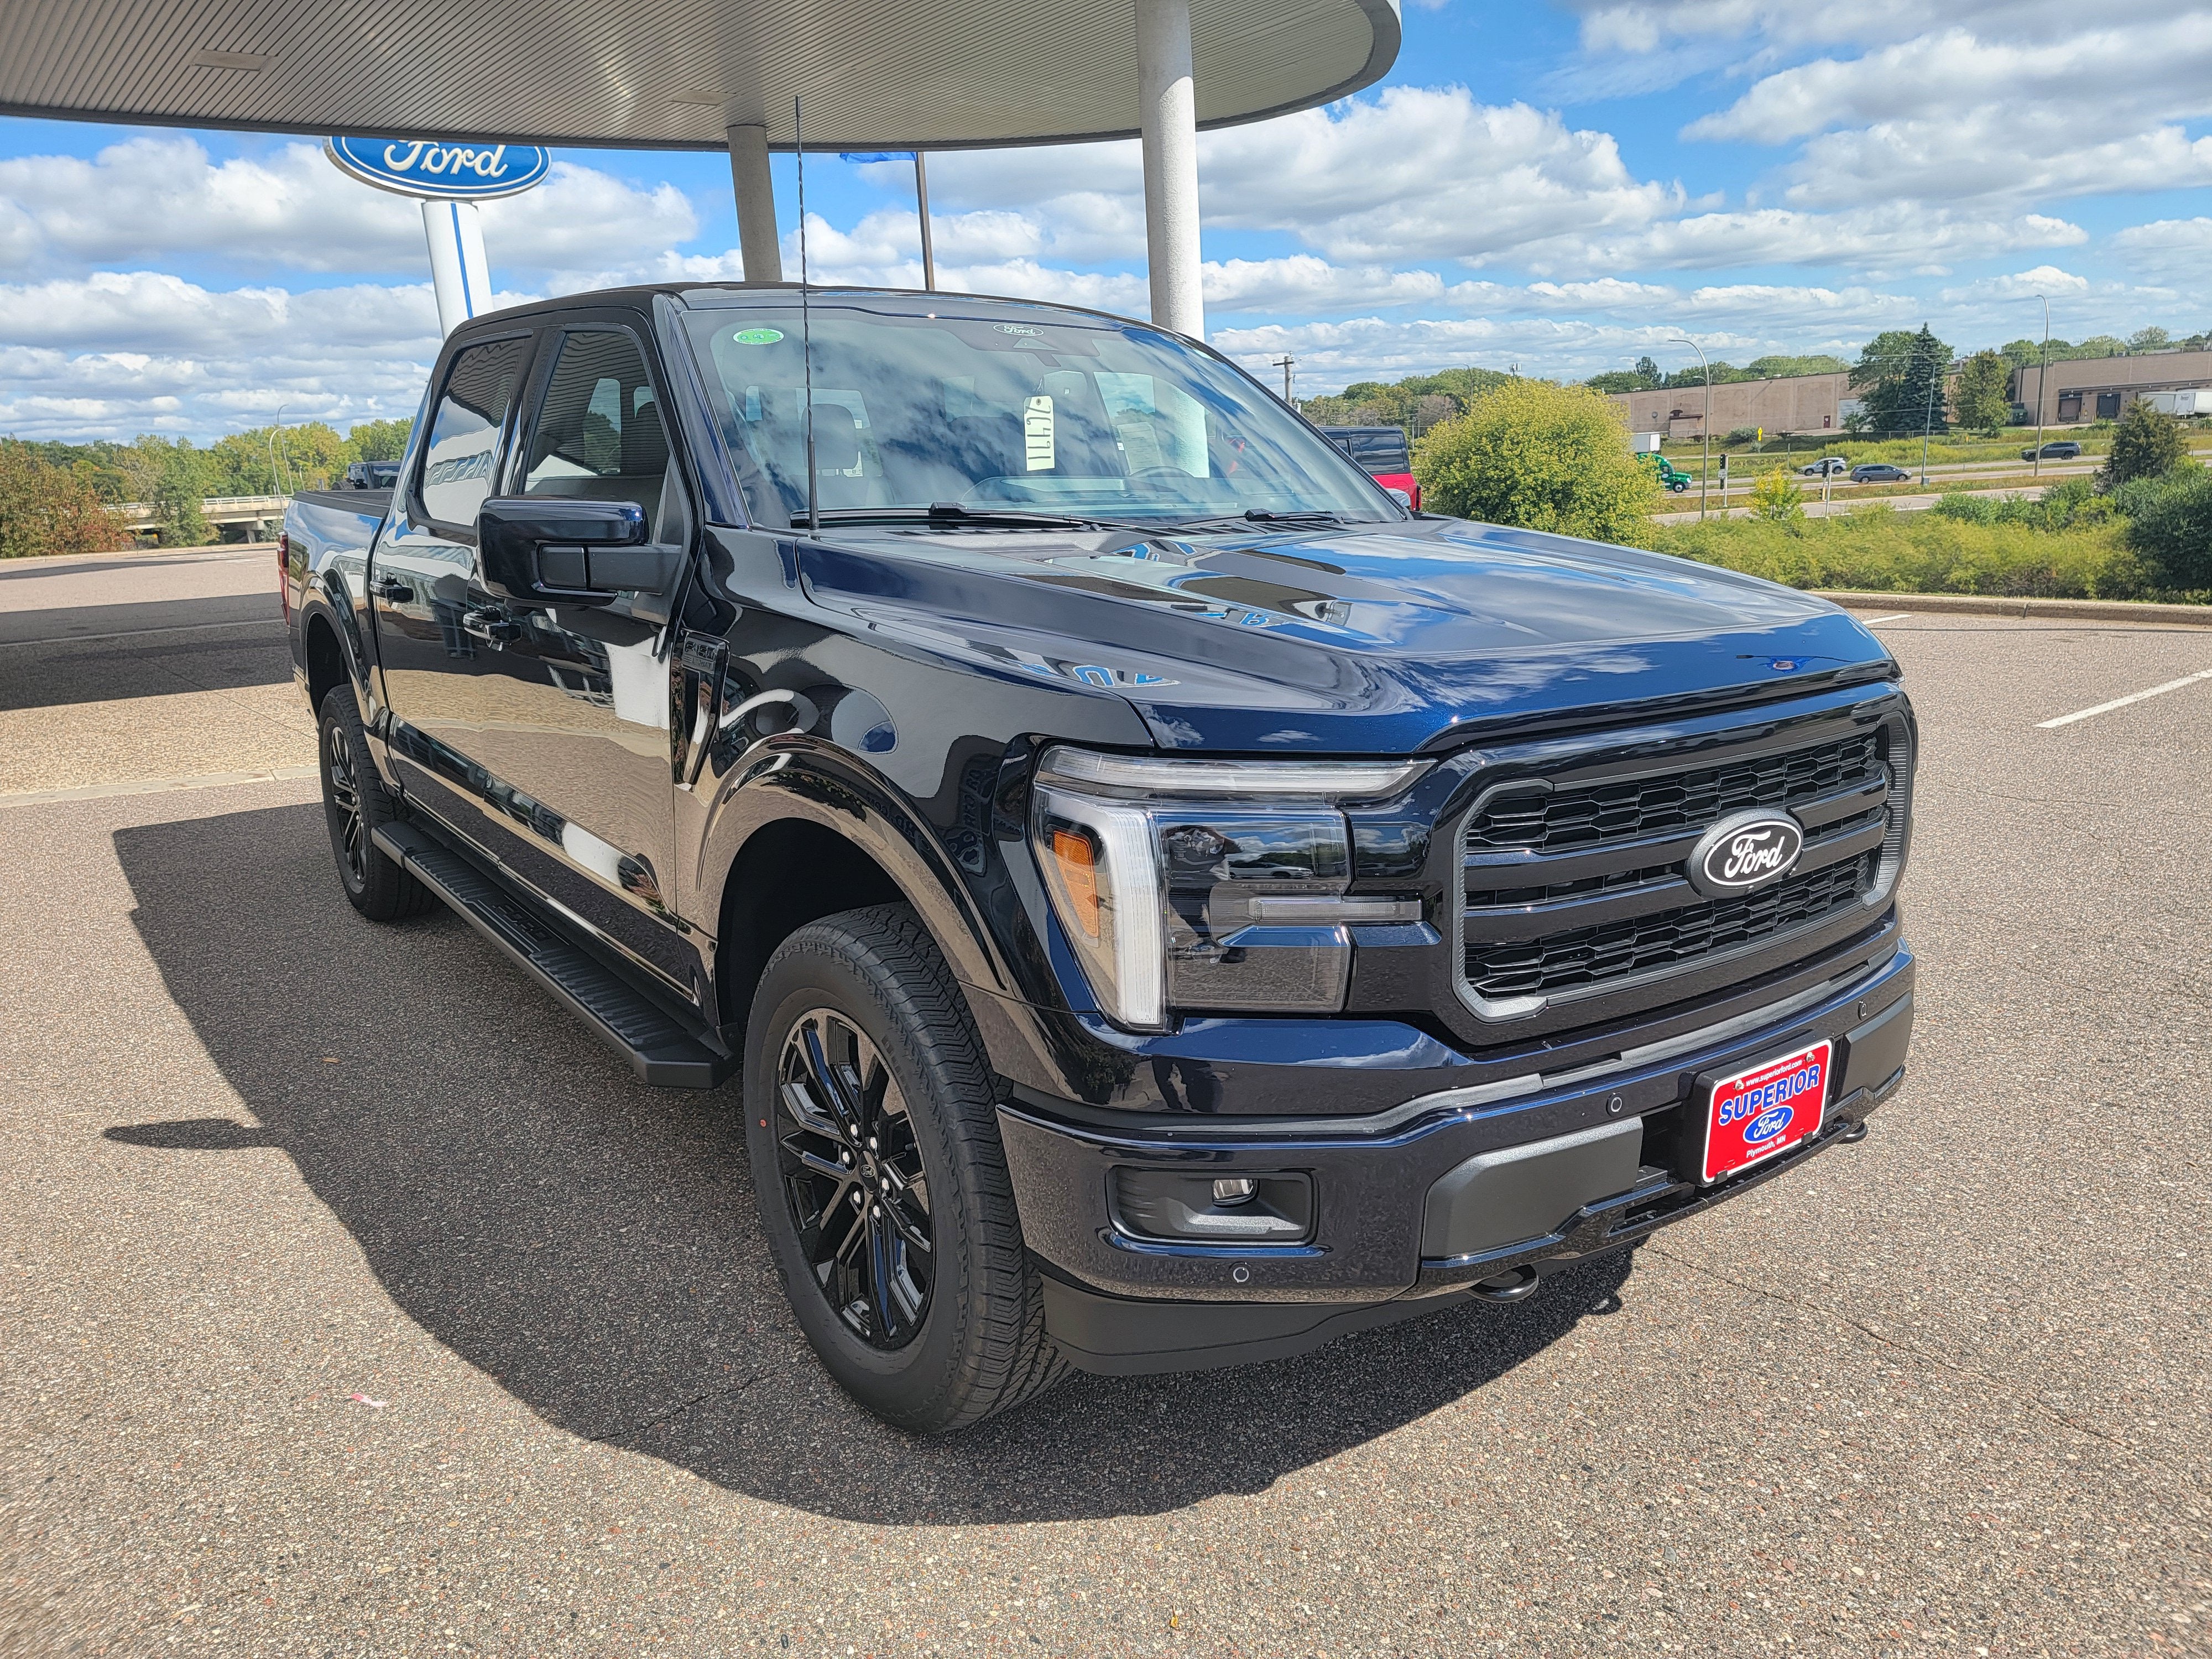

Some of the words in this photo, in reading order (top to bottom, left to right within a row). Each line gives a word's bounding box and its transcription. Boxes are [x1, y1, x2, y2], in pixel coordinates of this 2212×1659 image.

[384, 140, 508, 178] Ford
[1003, 325, 1036, 335] Ford
[1025, 405, 1051, 460] 26491
[1724, 830, 1785, 878] Ford
[1746, 1060, 1802, 1087] www.superiorford.com
[1718, 1063, 1820, 1126] SUPERIOR
[1753, 1111, 1786, 1139] Ford
[1746, 1140, 1775, 1159] Plymouth,
[1776, 1134, 1786, 1145] MN
